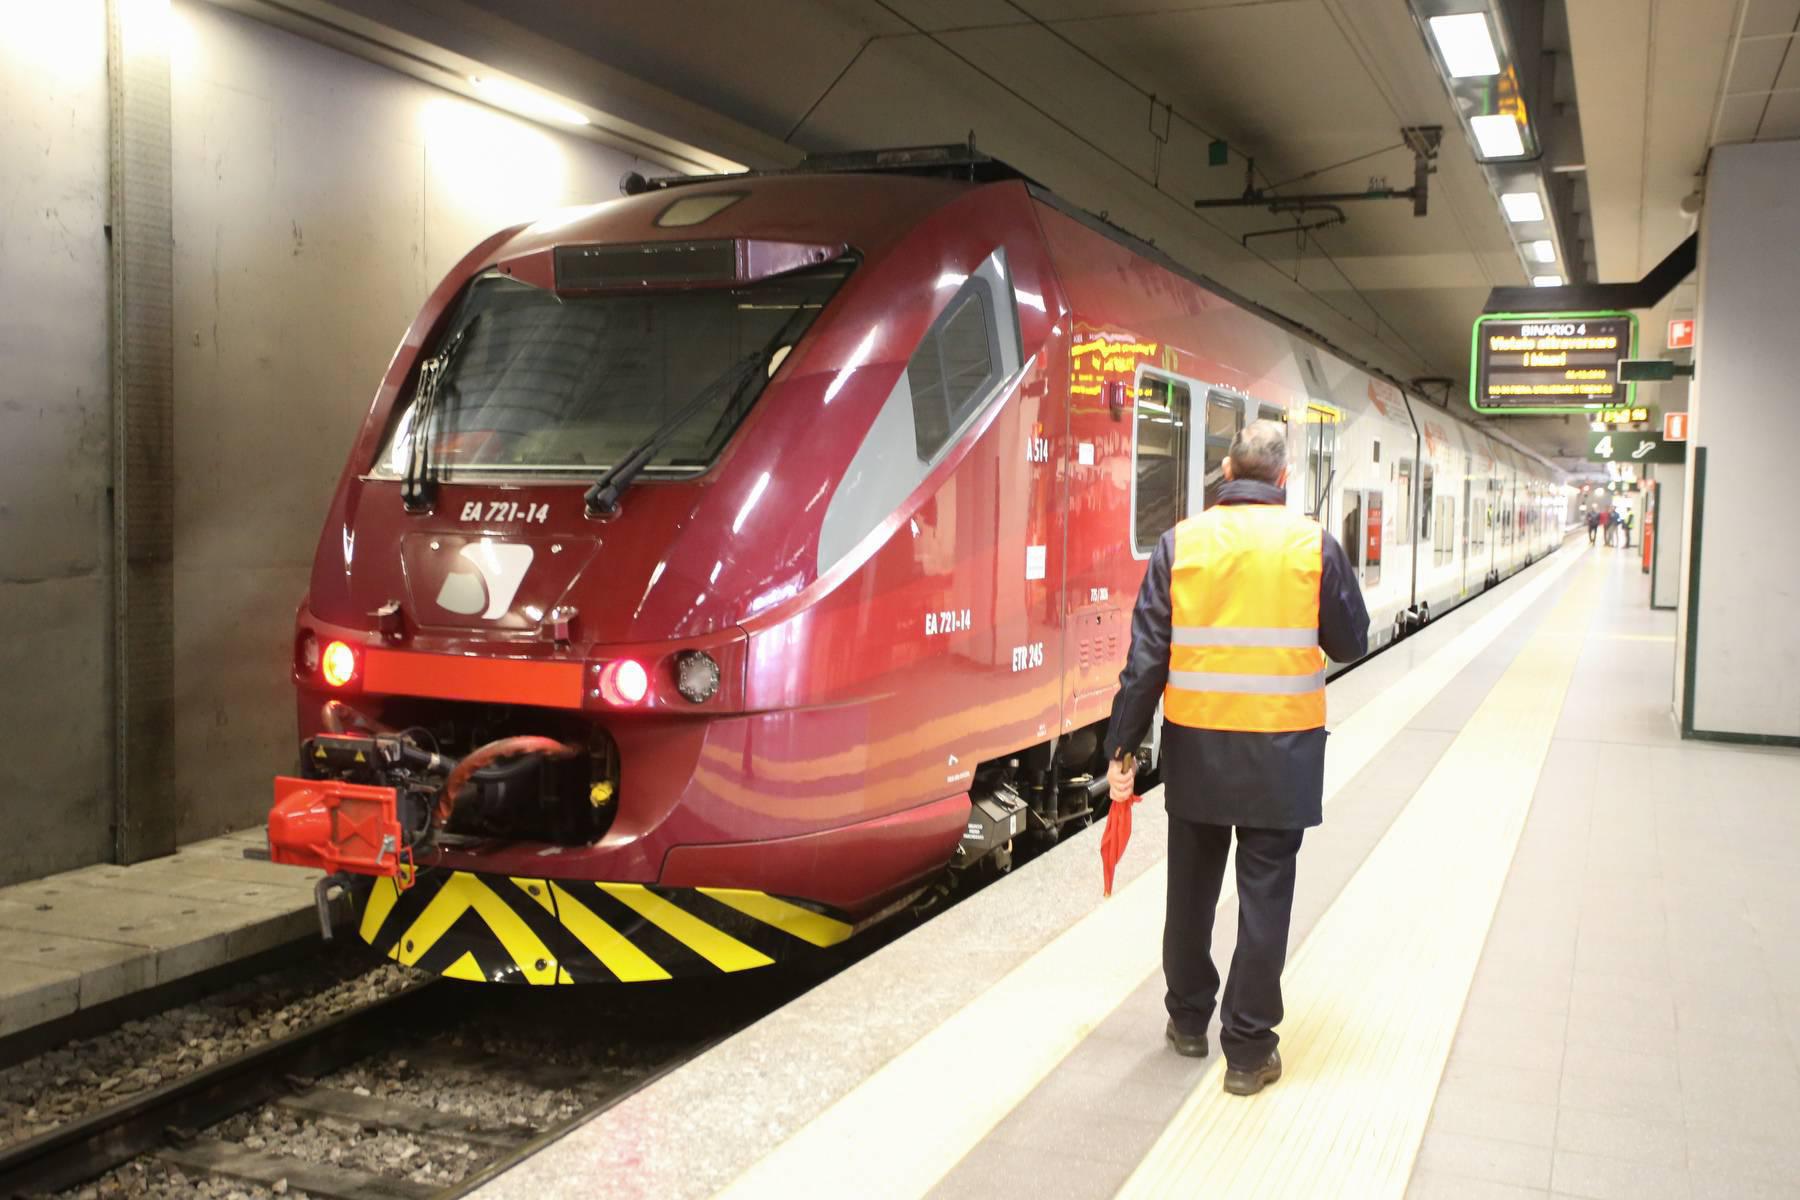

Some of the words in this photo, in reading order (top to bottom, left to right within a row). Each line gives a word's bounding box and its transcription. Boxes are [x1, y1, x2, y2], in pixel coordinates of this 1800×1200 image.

[1521, 324, 1575, 336] BINARIO
[1577, 323, 1586, 336] 4
[1026, 438, 1032, 462] A
[1033, 438, 1048, 463] 514
[1594, 435, 1613, 458] 4
[460, 501, 483, 521] EA
[485, 501, 550, 524] 721-14
[925, 612, 937, 635] EA
[940, 608, 971, 634] 721-14
[1012, 645, 1027, 672] ETR
[1028, 642, 1043, 668] 245
